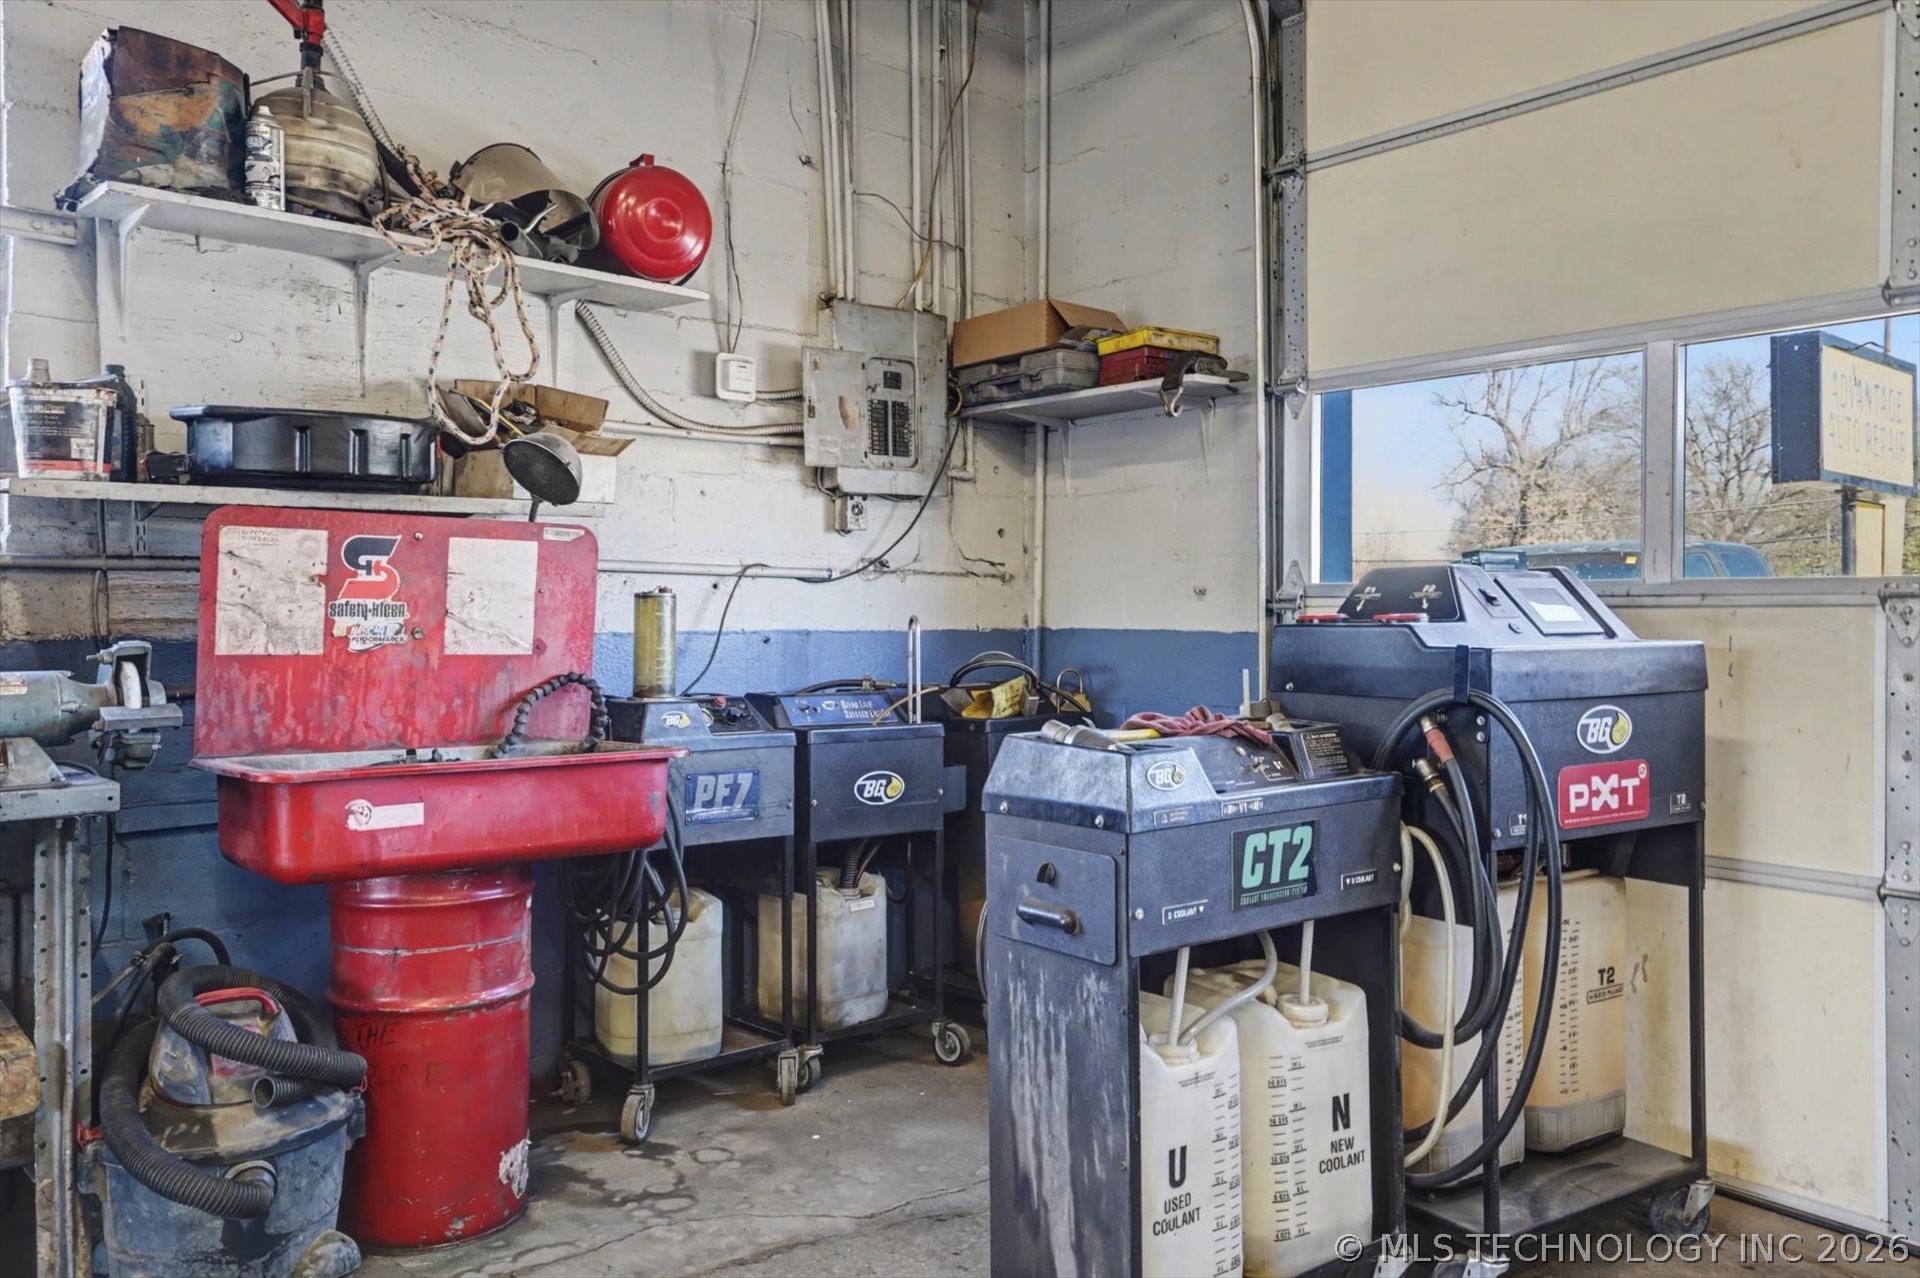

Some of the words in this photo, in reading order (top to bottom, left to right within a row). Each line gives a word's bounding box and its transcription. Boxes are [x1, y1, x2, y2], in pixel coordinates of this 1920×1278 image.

[1582, 716, 1613, 744] BG
[693, 772, 754, 810] PF7
[857, 779, 888, 799] BG
[1241, 825, 1313, 889] CT2
[1598, 966, 1615, 986] T2
[1332, 1093, 1350, 1132] N
[1330, 1136, 1354, 1154] NEW
[1168, 1145, 1187, 1189] U
[1319, 1150, 1366, 1174] COOLANT
[1163, 1192, 1192, 1215] USED
[1153, 1207, 1201, 1236] COOLANT
